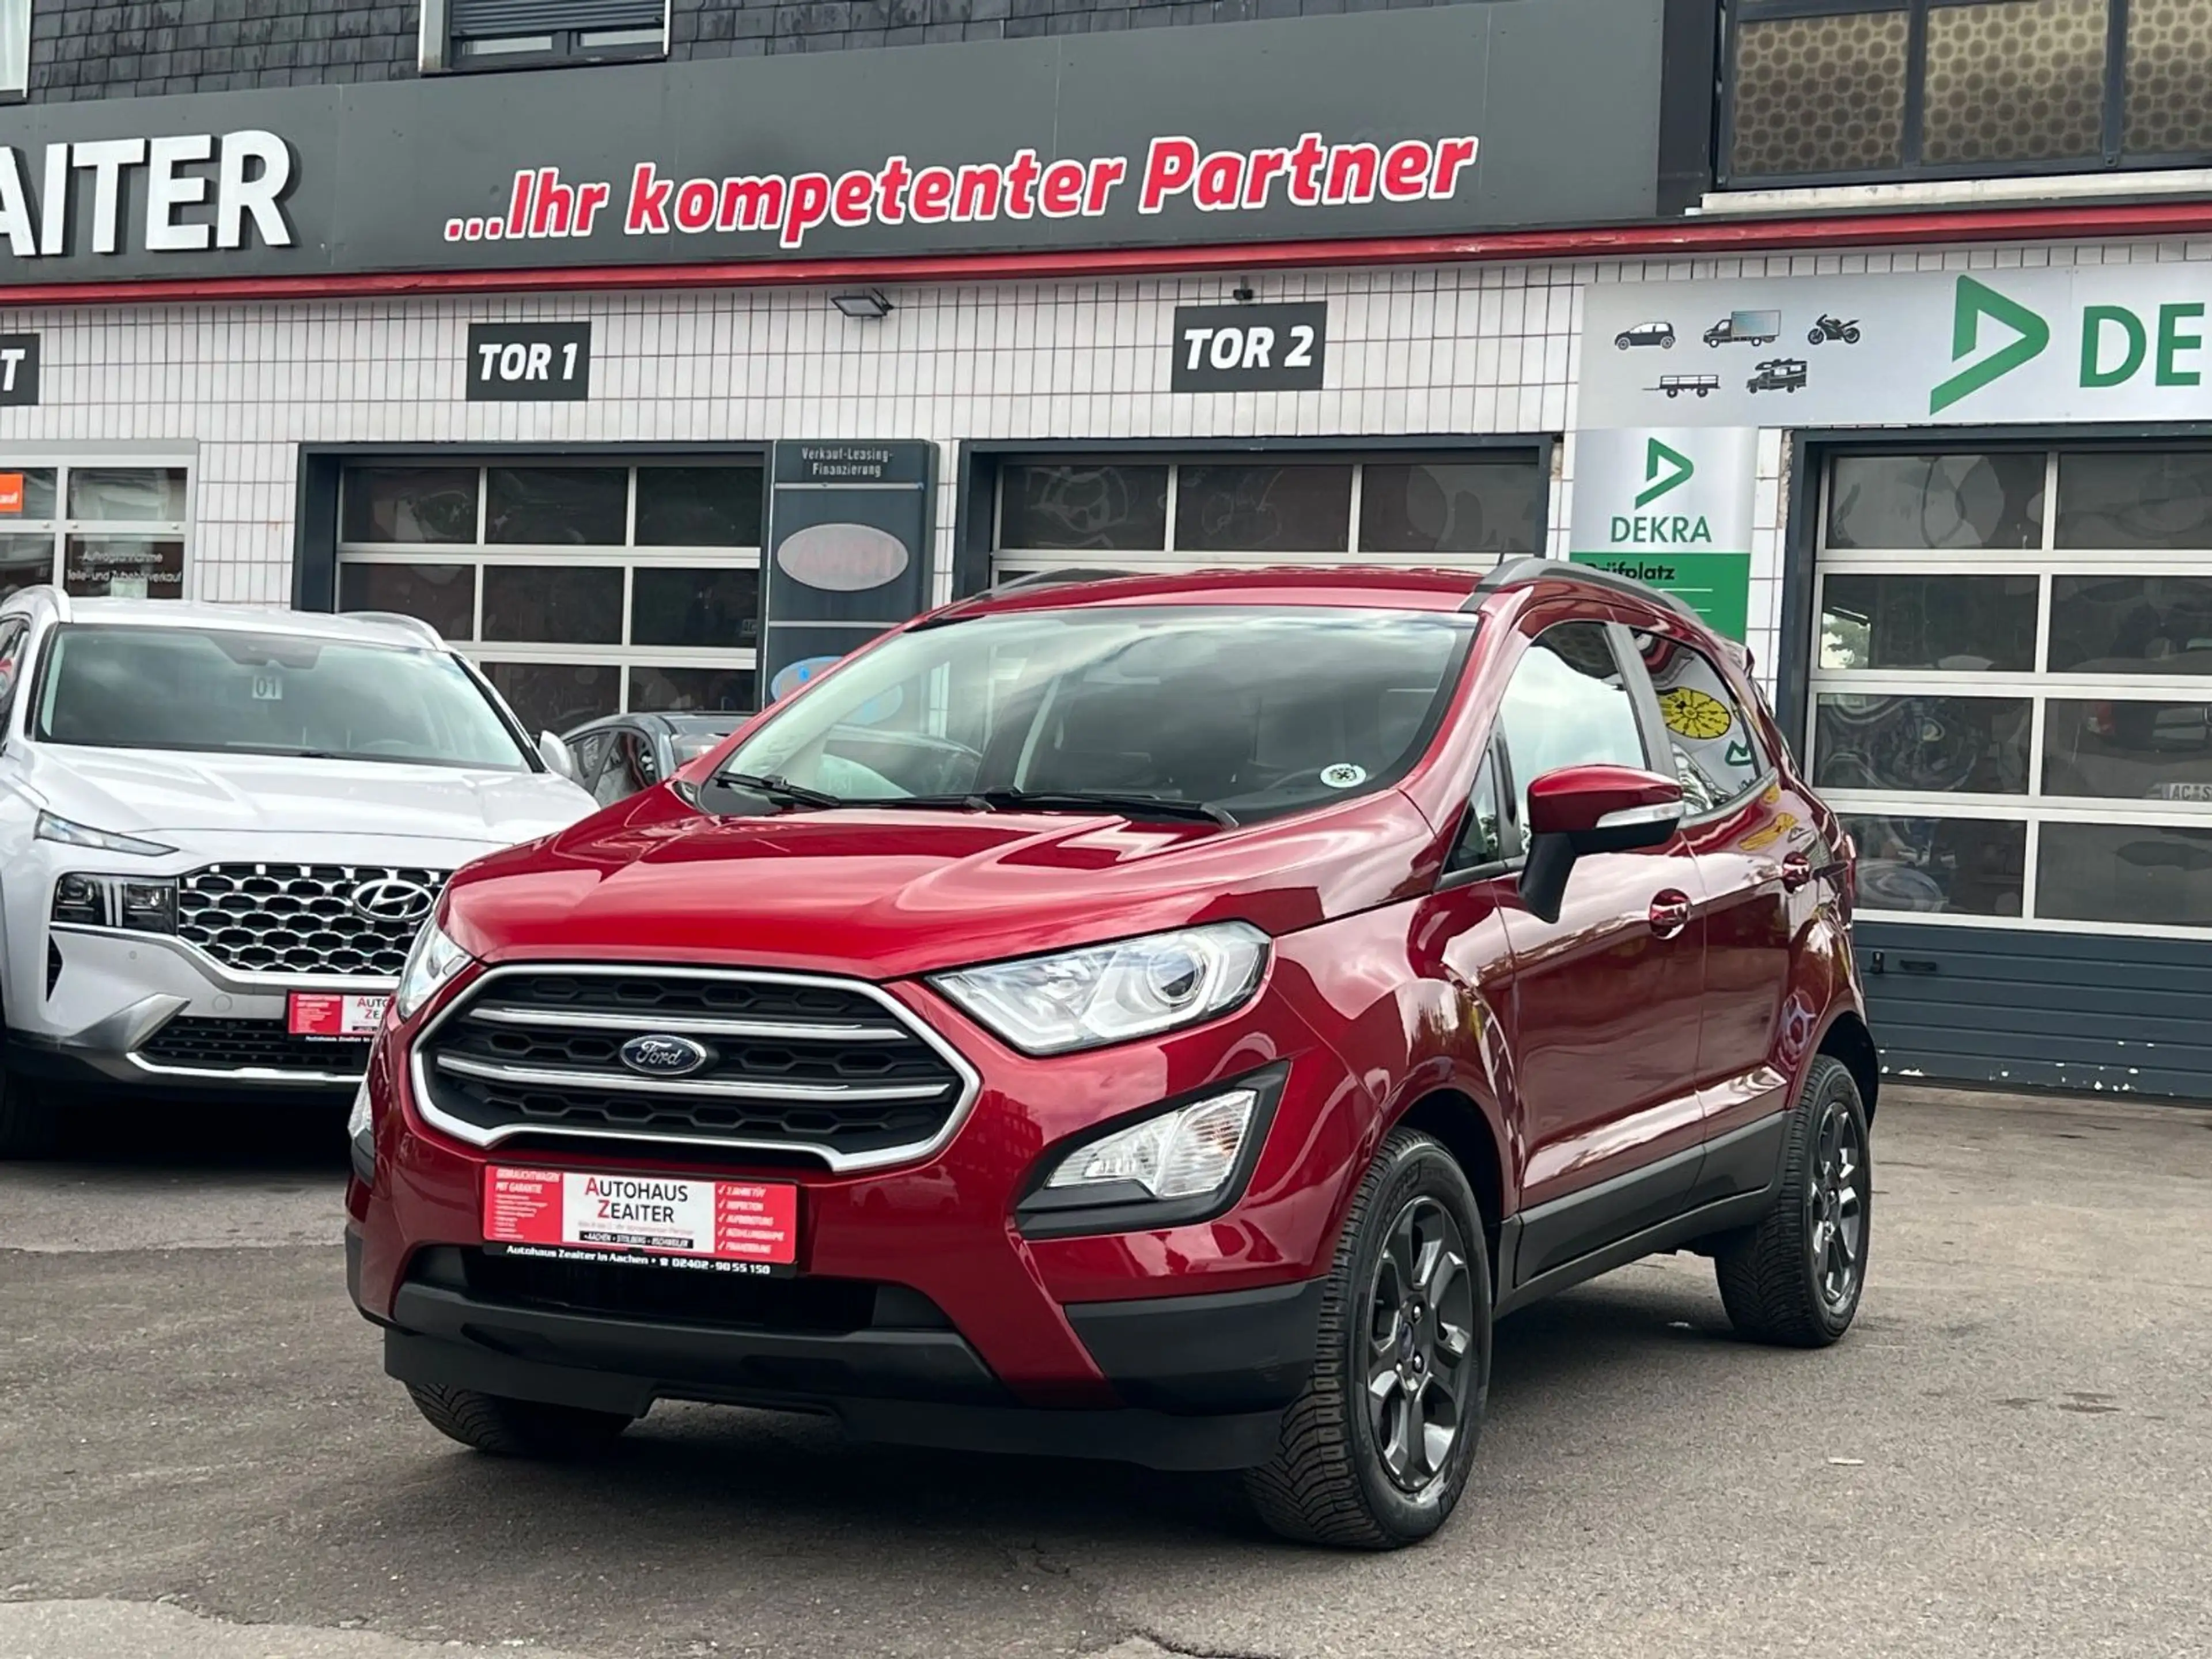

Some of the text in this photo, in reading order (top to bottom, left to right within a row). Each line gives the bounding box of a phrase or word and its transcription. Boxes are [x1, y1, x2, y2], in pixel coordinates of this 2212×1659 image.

[445, 132, 1479, 248] ...Ihr kompetenter Partner
[1183, 324, 1315, 370] TOR 2
[2080, 302, 2205, 388] DE
[478, 342, 578, 382] TOR 1
[812, 462, 881, 478] Finanzierung
[1611, 516, 1713, 543] DEKRA
[256, 677, 276, 698] 01
[636, 1040, 683, 1065] Ford
[585, 1177, 688, 1203] AUTOHAUS
[597, 1199, 675, 1224] ZEAITER
[506, 1245, 556, 1257] Autohaus
[558, 1248, 596, 1261] Zeaiter
[597, 1251, 608, 1262] in
[609, 1252, 649, 1265] Aachen
